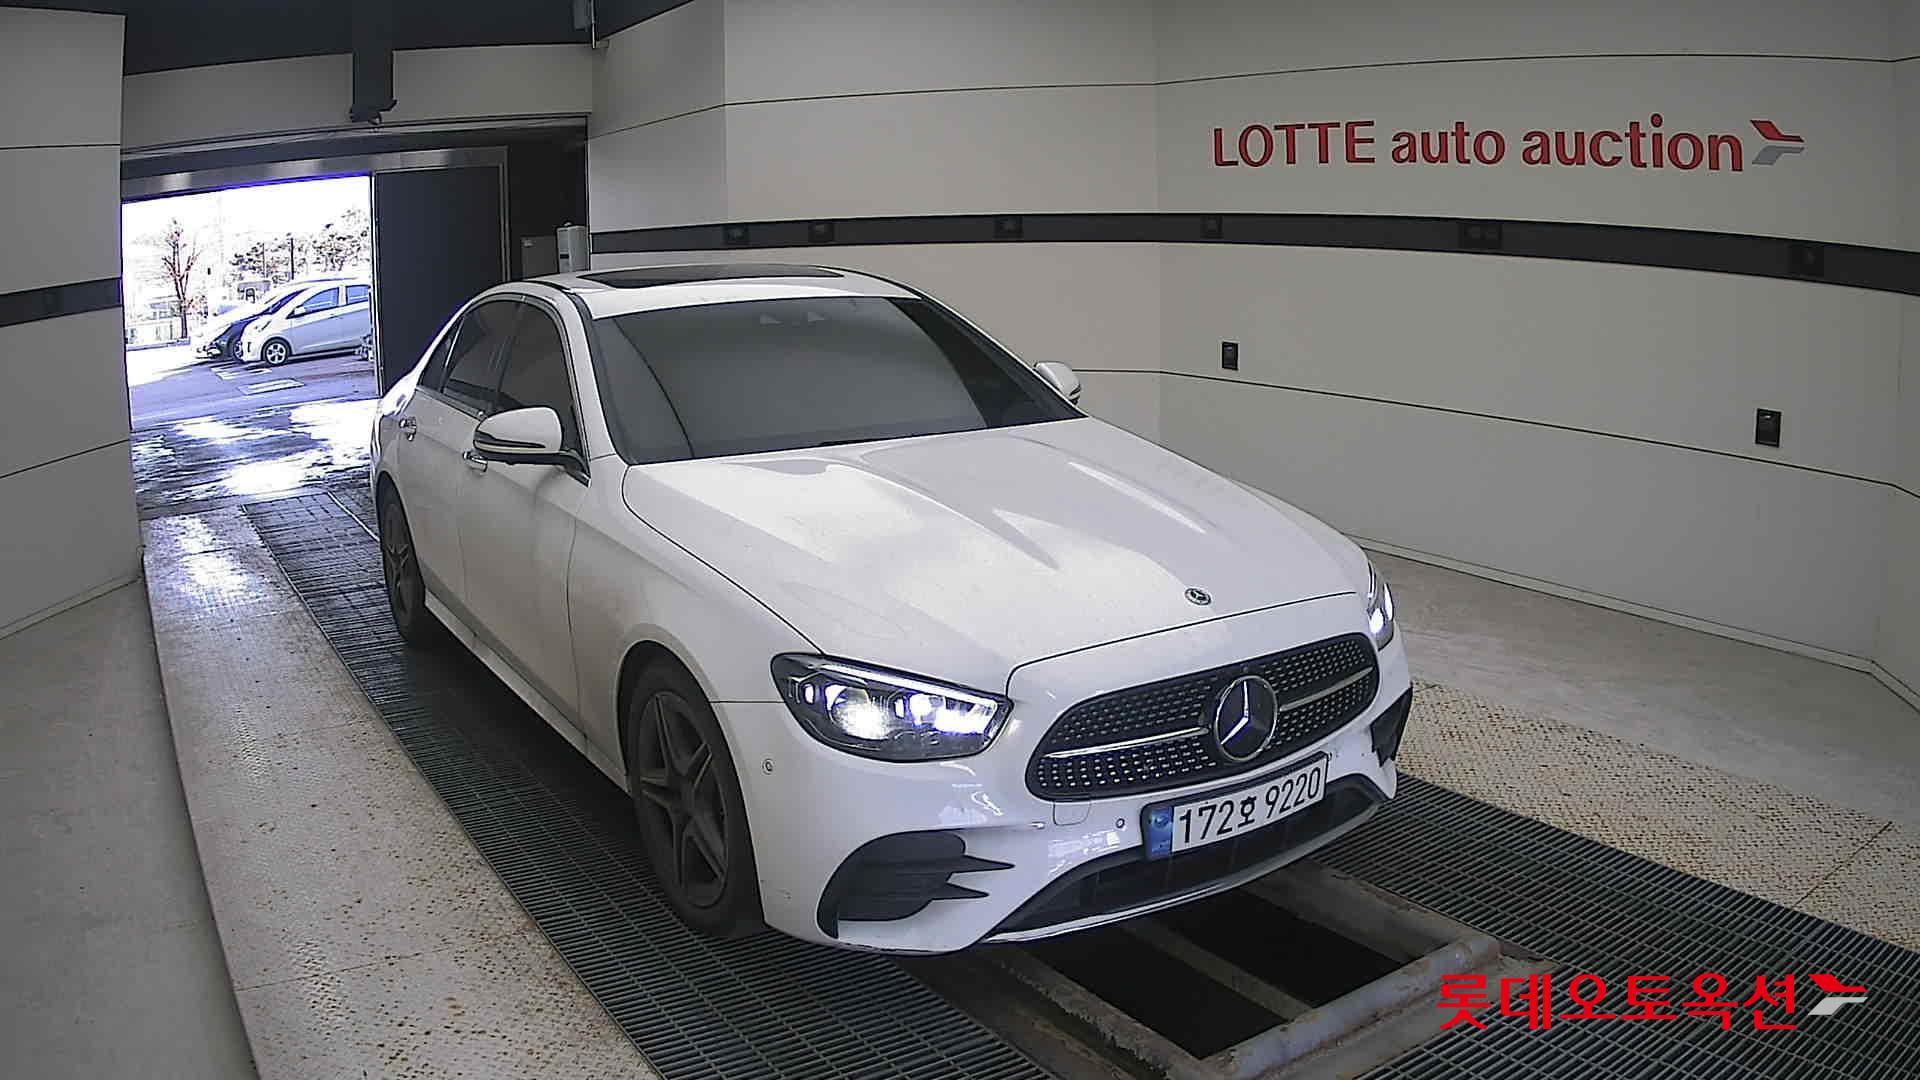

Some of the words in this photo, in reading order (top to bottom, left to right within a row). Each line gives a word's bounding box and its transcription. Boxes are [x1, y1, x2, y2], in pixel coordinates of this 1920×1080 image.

[1212, 120, 1376, 167] LOTTE
[1391, 121, 1505, 166] auto
[1521, 113, 1743, 172] auction
[1178, 796, 1257, 844] 172호
[1264, 766, 1321, 819] 9220
